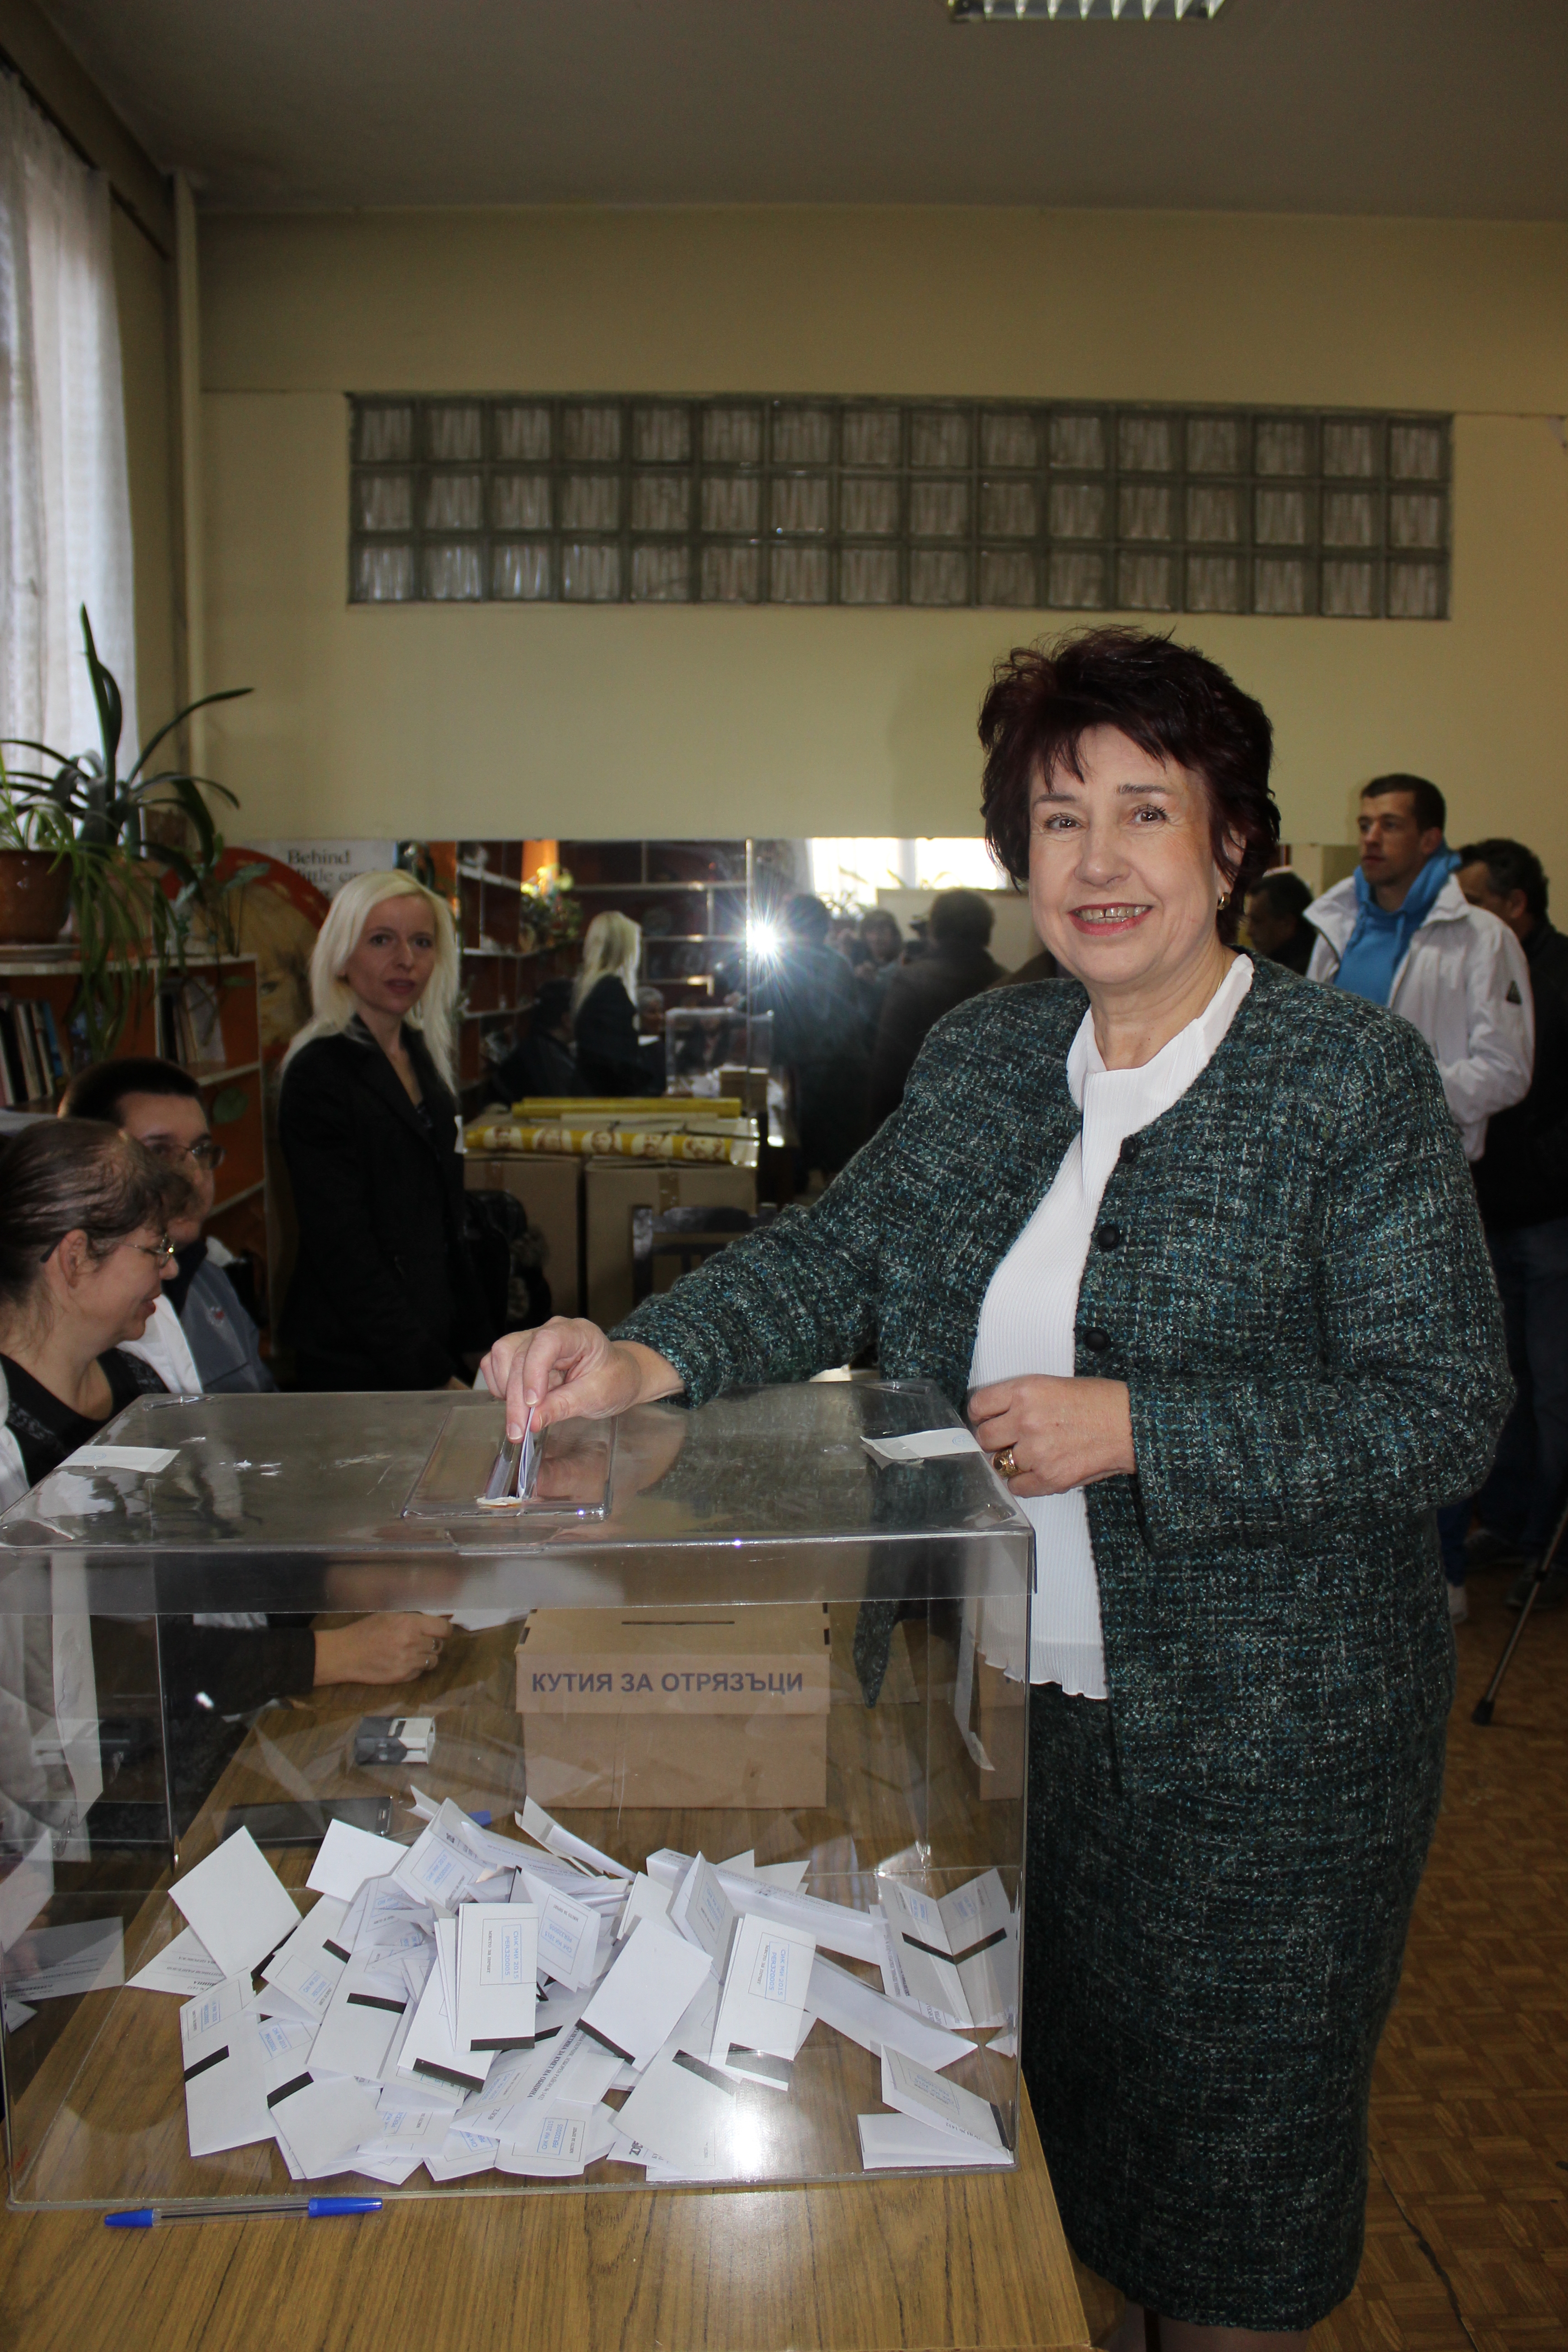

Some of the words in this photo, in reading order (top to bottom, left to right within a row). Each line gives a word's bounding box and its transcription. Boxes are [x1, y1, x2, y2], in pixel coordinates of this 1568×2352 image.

[288, 849, 349, 864] Behind
[532, 1673, 612, 1692] КУТИЯ
[621, 1673, 653, 1692] ЗА
[661, 1672, 803, 1695] ОТРЯЗЪЦИ
[544, 1931, 555, 1941] 2015
[514, 1948, 519, 1959] МИ
[779, 1965, 784, 1976] МИ
[558, 2048, 565, 2057] ЗА
[550, 2055, 561, 2069] КМЕТ
[543, 2068, 551, 2078] НА
[527, 2076, 546, 2098] ОБЩИНА
[547, 2073, 559, 2090] РАЙОН
[538, 2091, 547, 2101] 1432
[552, 2124, 563, 2148] PER320005
